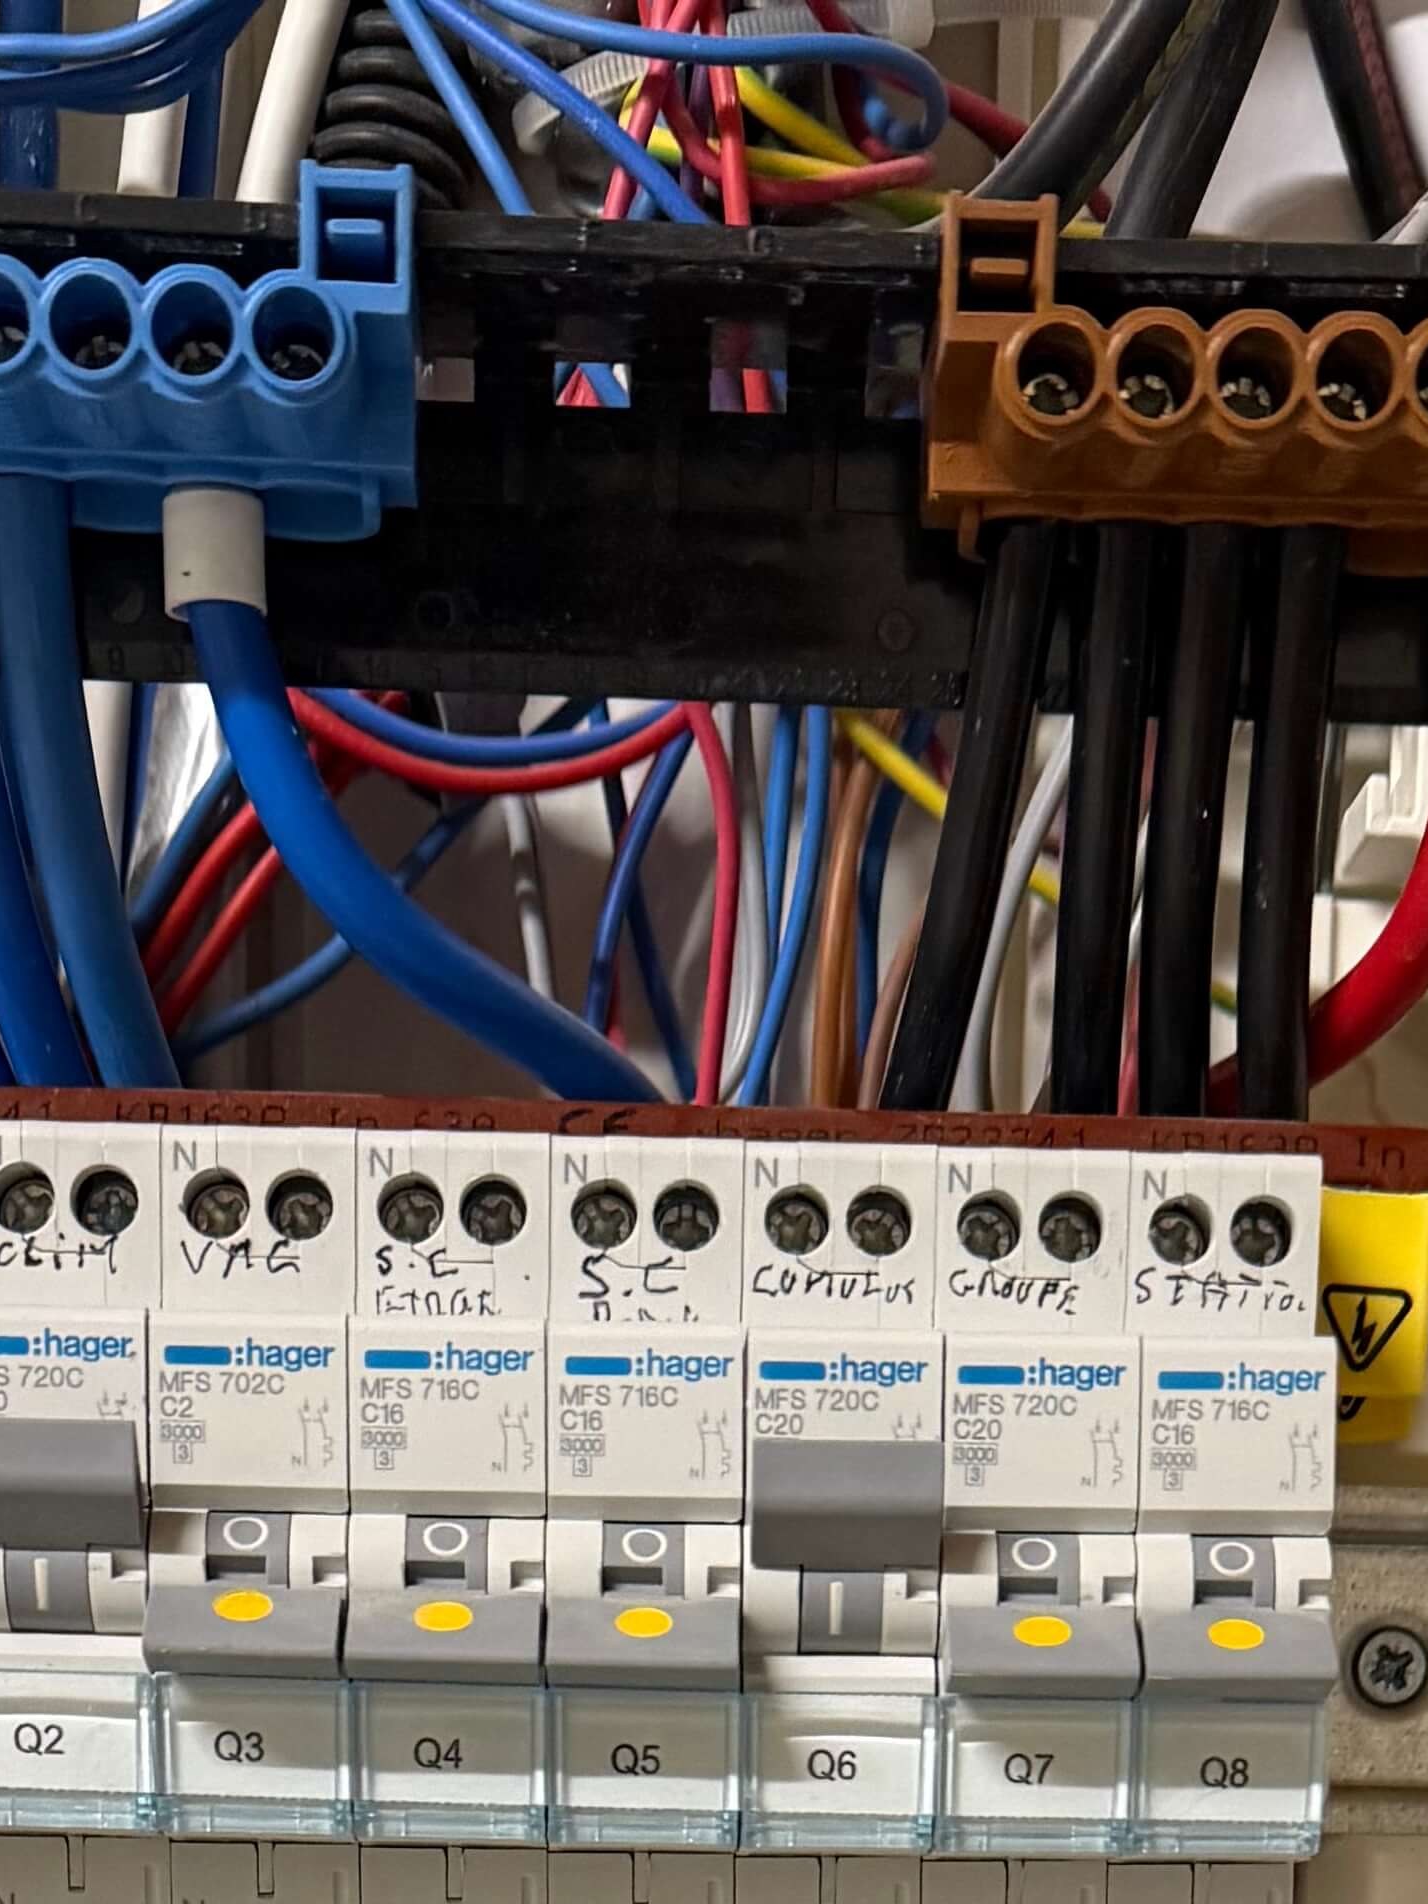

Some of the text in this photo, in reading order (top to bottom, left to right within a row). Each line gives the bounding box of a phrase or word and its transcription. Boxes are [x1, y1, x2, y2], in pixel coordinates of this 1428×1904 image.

[159, 1371, 285, 1395] MFS 702C
[160, 1396, 193, 1417] C2
[14, 1724, 65, 1756] Q2
[214, 1731, 265, 1763] Q3
[414, 1738, 463, 1770] Q4
[611, 1744, 661, 1775] Q5
[808, 1749, 857, 1782] Q6
[1004, 1754, 1055, 1786] Q7
[1200, 1757, 1250, 1788] Q8
